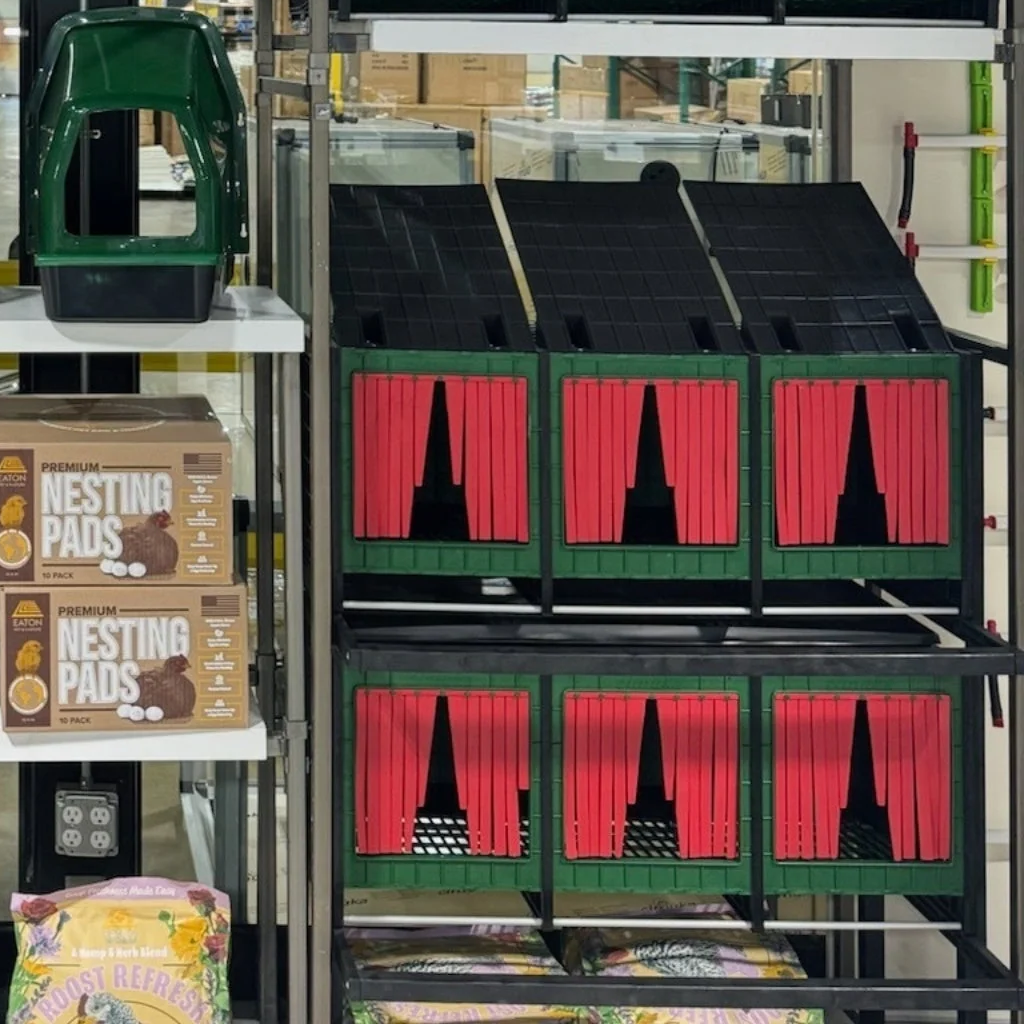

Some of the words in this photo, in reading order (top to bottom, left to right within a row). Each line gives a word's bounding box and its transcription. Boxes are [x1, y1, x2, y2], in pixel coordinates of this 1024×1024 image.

[41, 462, 99, 472] PREMIUM
[41, 472, 173, 514] NESTING
[41, 514, 123, 558] PADS
[13, 619, 43, 627] EATON
[58, 606, 117, 616] PREMIUM
[57, 616, 189, 661] NESTING
[57, 659, 141, 705] PADS
[129, 886, 153, 896] Made
[155, 886, 176, 897] Easy
[71, 948, 77, 958] A
[79, 947, 105, 959] Hemp
[116, 947, 139, 958] Herb
[141, 947, 168, 958] Blend
[36, 966, 105, 1023] ROOST
[114, 963, 209, 1024] REFRESH
